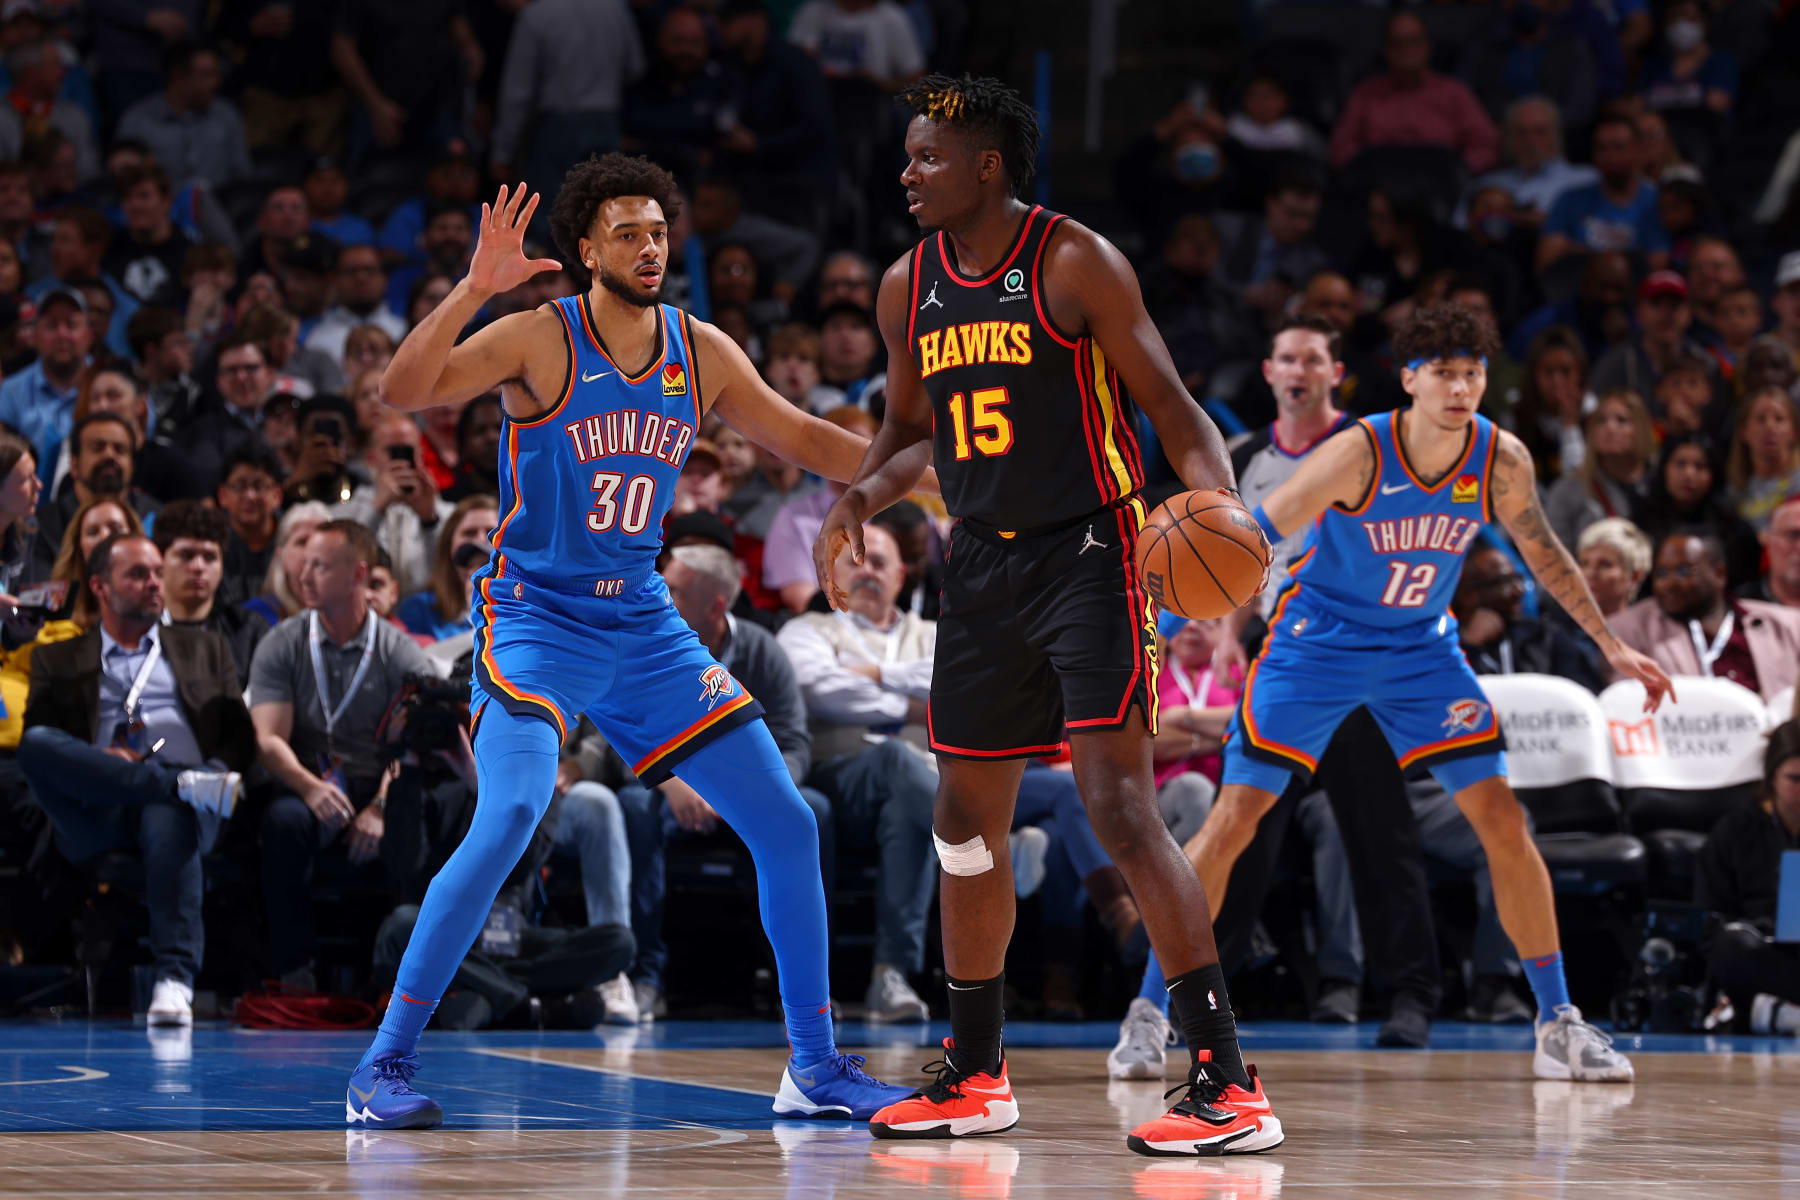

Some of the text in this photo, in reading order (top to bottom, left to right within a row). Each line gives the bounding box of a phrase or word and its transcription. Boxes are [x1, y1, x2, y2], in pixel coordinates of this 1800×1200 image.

[918, 321, 1033, 379] HAWKS
[565, 409, 693, 468] THUNDER
[948, 386, 1014, 461] 15
[587, 471, 656, 535] 30
[1361, 513, 1480, 555] THUNDER
[595, 578, 624, 597] OKC
[1379, 560, 1437, 608] 12
[1507, 736, 1561, 755] ANK
